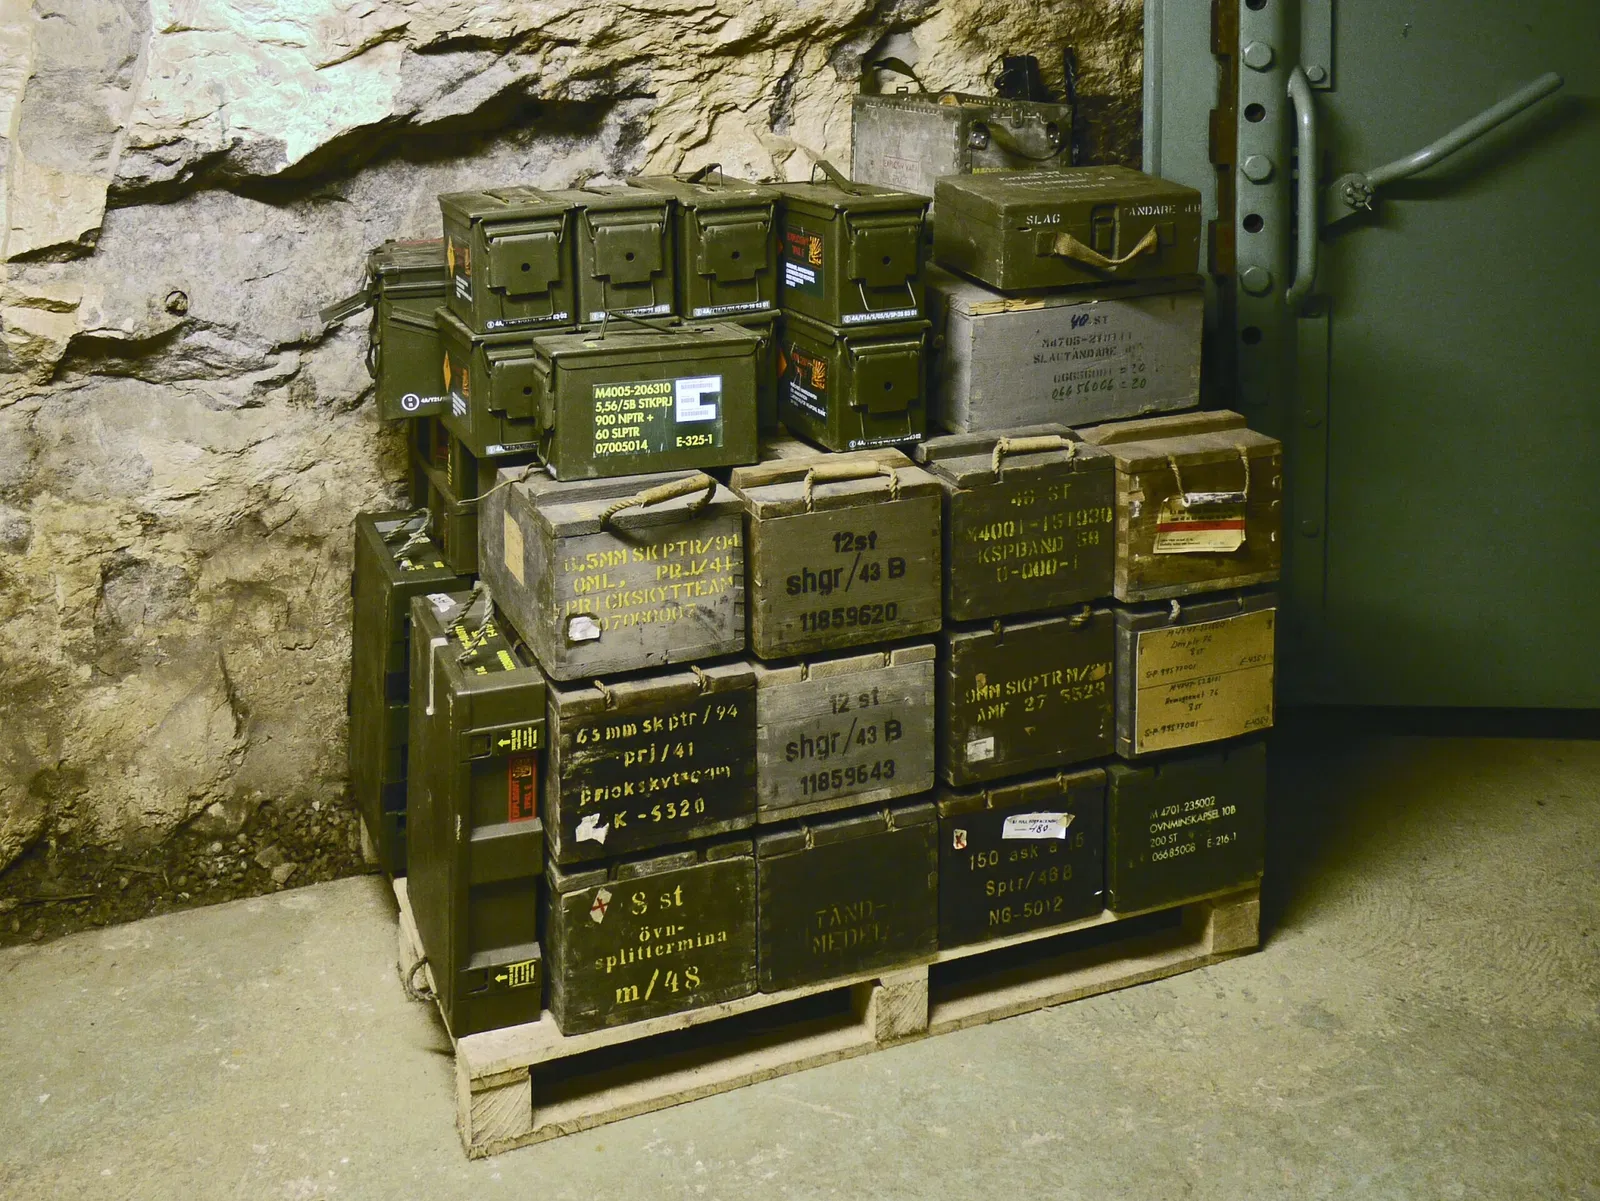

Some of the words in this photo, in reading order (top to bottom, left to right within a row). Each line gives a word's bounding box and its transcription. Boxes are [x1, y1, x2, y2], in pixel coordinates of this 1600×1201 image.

[594, 382, 671, 399] M4005-206310
[595, 398, 636, 414] 5,56/5B
[638, 395, 673, 408] STKPRJ
[595, 414, 616, 427] 900
[618, 412, 645, 425] NPTR
[595, 430, 609, 441] 60
[611, 426, 640, 439] SLPTR
[595, 438, 649, 454] 07005014
[675, 433, 713, 448] E-325-1
[978, 535, 1064, 564] KSPBAND
[786, 551, 881, 596] shgr/43
[887, 556, 907, 579] B
[800, 601, 898, 633] 11859620
[829, 691, 850, 714] 12
[859, 686, 879, 708] st
[1024, 694, 1047, 712] 27
[785, 716, 877, 763] shgr/43
[884, 719, 902, 742] B
[800, 758, 896, 795] 11859643
[1150, 835, 1167, 848] 200
[1168, 832, 1178, 844] ST
[969, 849, 999, 871] 150
[1009, 843, 1040, 863] ask
[631, 890, 648, 916] 8
[659, 884, 684, 910] st
[989, 896, 1063, 926] NG-5012
[639, 923, 685, 942] övn-
[594, 930, 728, 974] splittermina
[615, 965, 701, 1004] m/48
